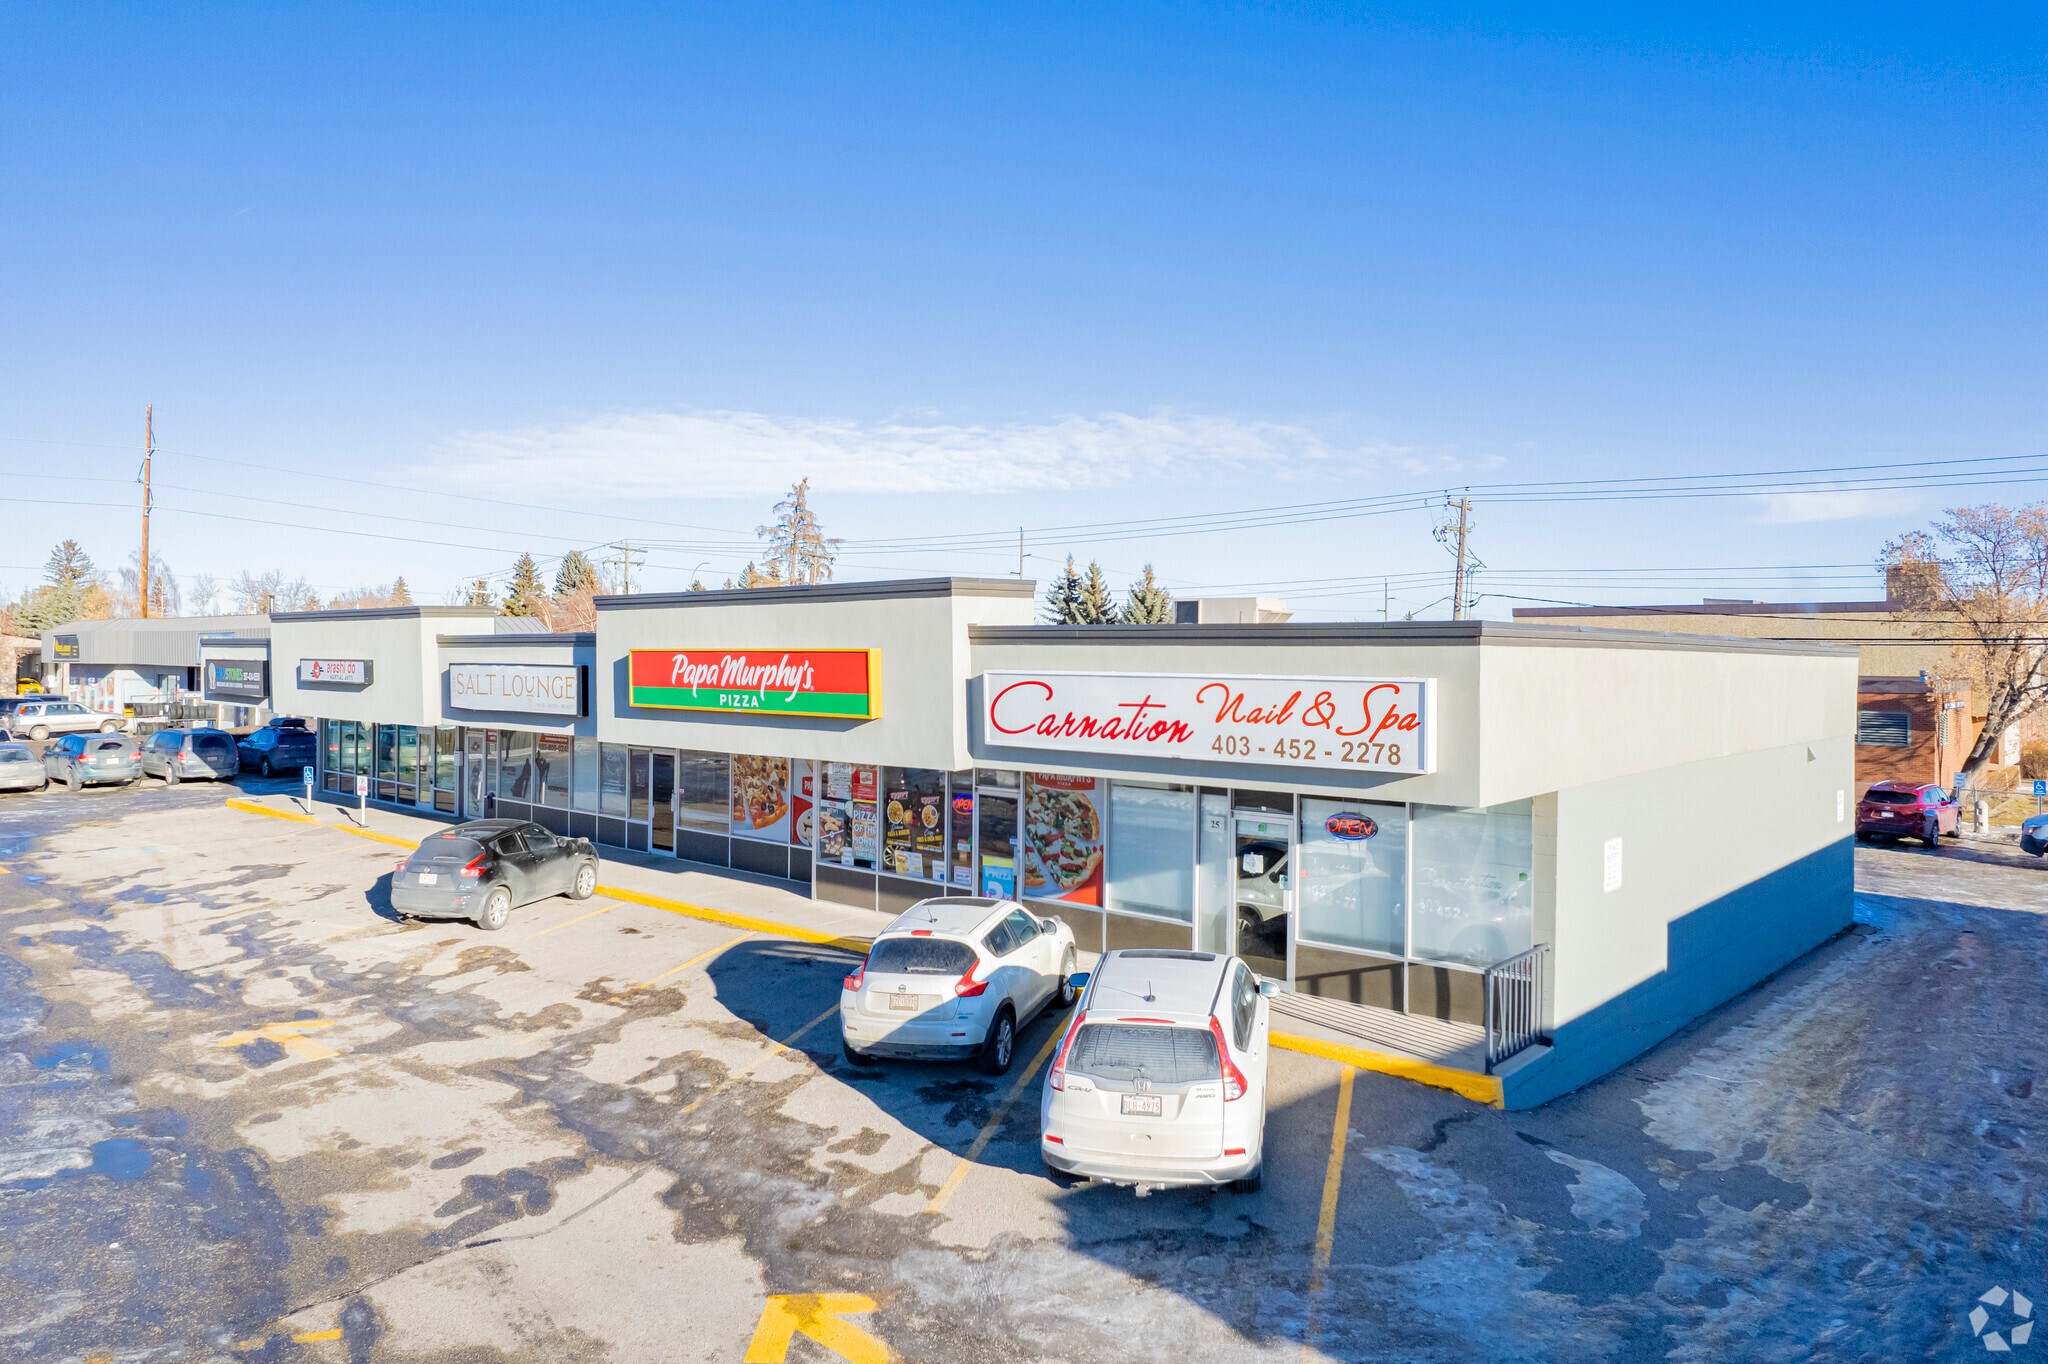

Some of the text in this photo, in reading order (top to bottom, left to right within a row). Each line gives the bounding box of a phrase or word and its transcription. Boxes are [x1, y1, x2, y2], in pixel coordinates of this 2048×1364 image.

[326, 660, 356, 674] arashi do
[456, 672, 497, 696] SALT
[502, 674, 576, 700] LOUNGE
[671, 653, 815, 702] Papa Murphy's
[719, 693, 760, 708] PIZZA
[989, 680, 1422, 743] Carnation Nail & Spa
[1211, 735, 1251, 757] 403
[1273, 737, 1317, 761] 452
[1341, 740, 1402, 767] 2278
[853, 810, 877, 822] PIZZA
[1210, 820, 1220, 829] 25
[1326, 817, 1374, 836] OPEN
